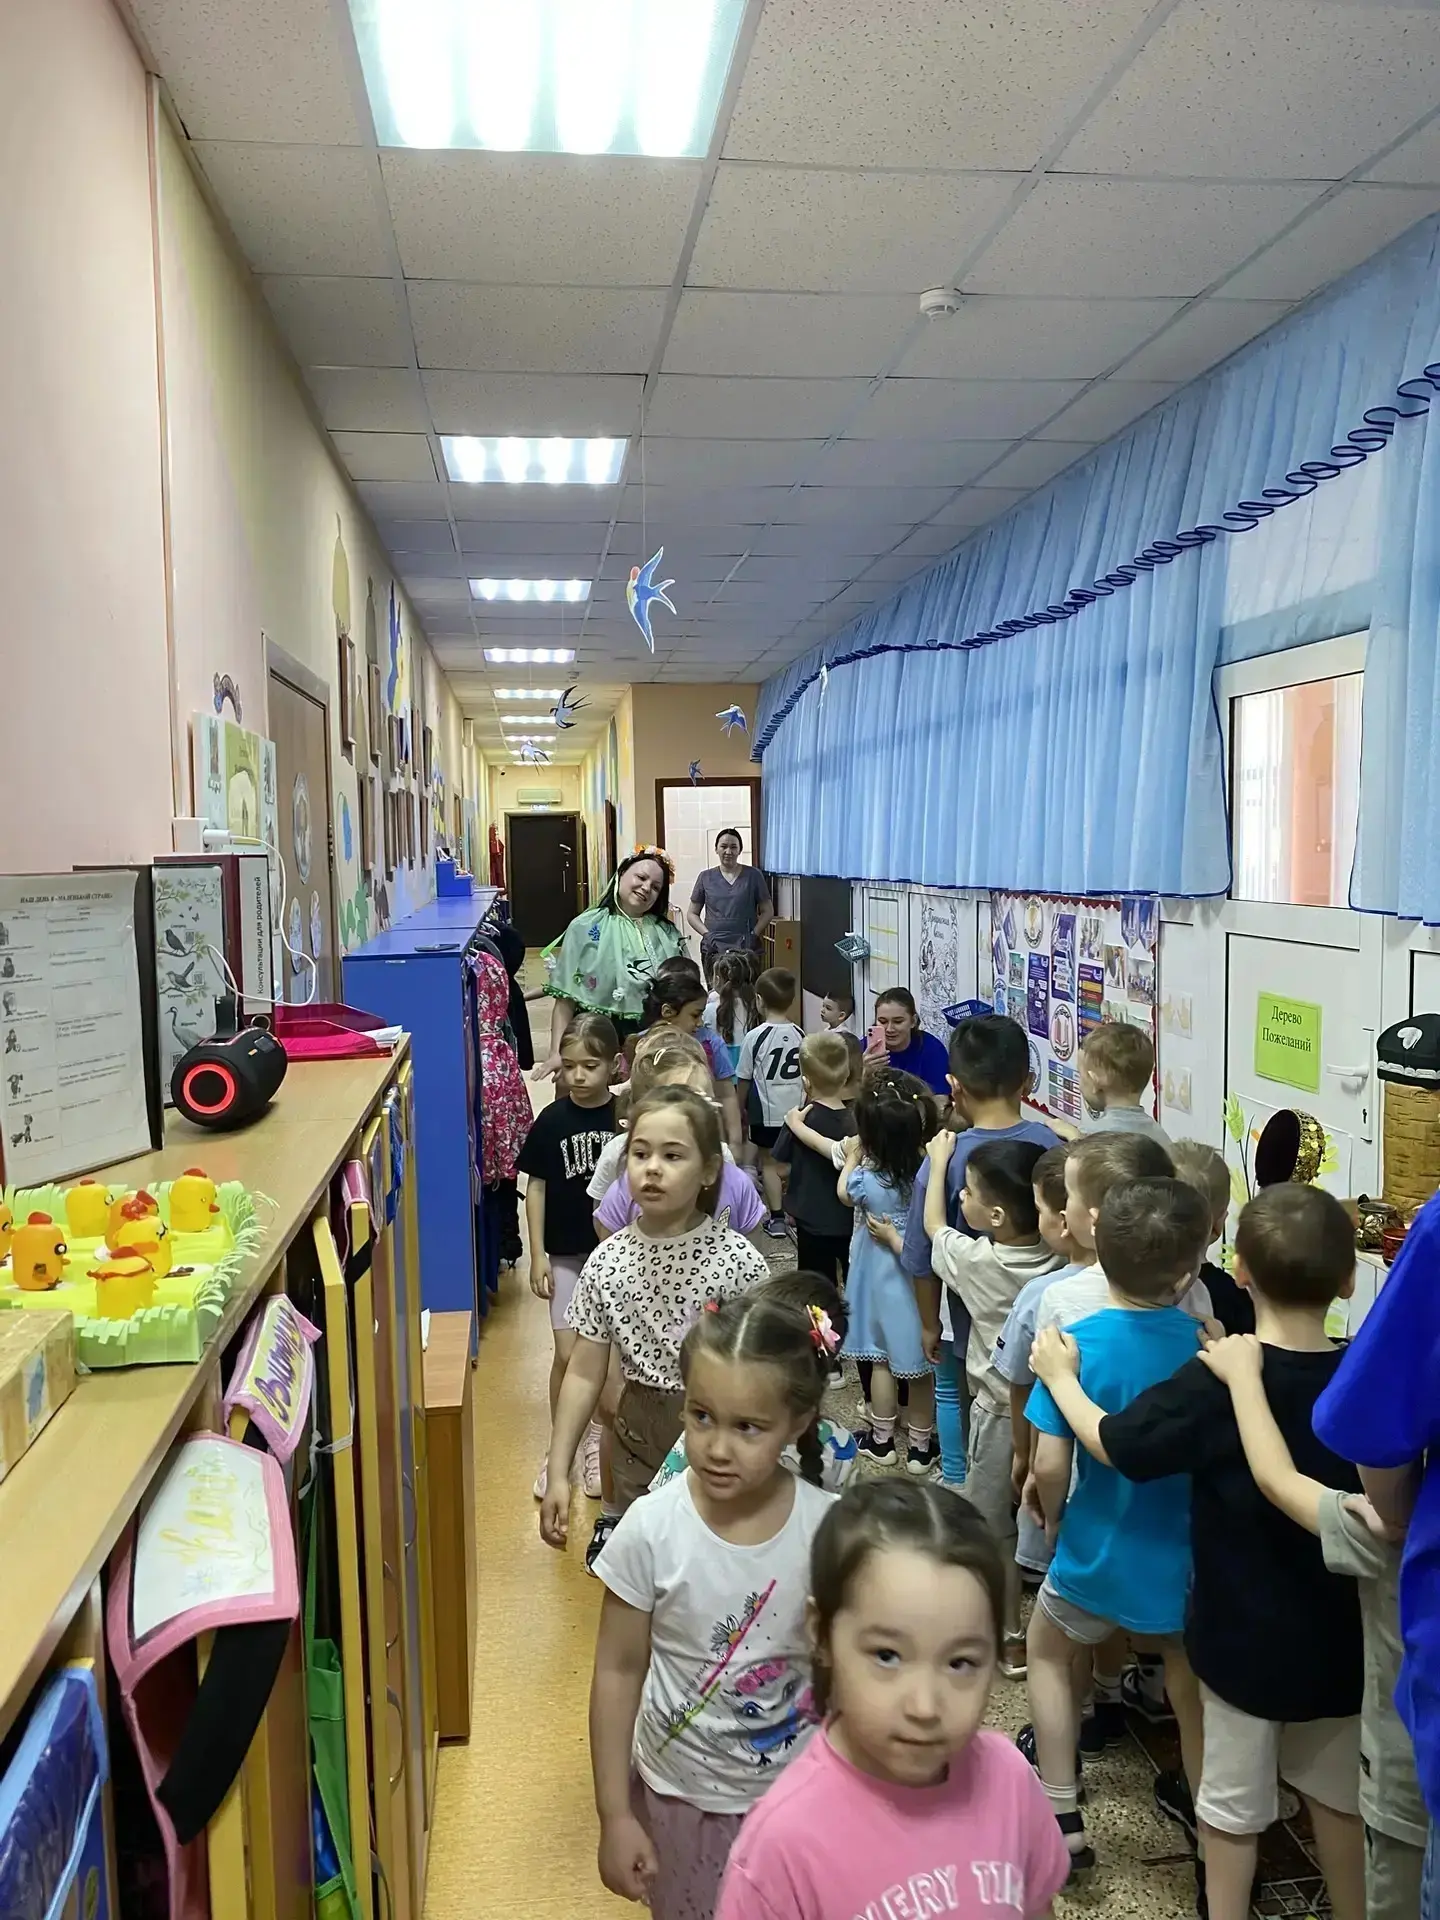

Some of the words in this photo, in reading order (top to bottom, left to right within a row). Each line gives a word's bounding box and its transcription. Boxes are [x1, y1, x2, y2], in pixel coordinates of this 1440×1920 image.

[254, 877, 263, 921] родителей
[256, 922, 264, 937] для
[1271, 1005, 1302, 1025] Дерево
[1262, 1027, 1311, 1052] Пожеланий
[766, 1047, 801, 1080] 18
